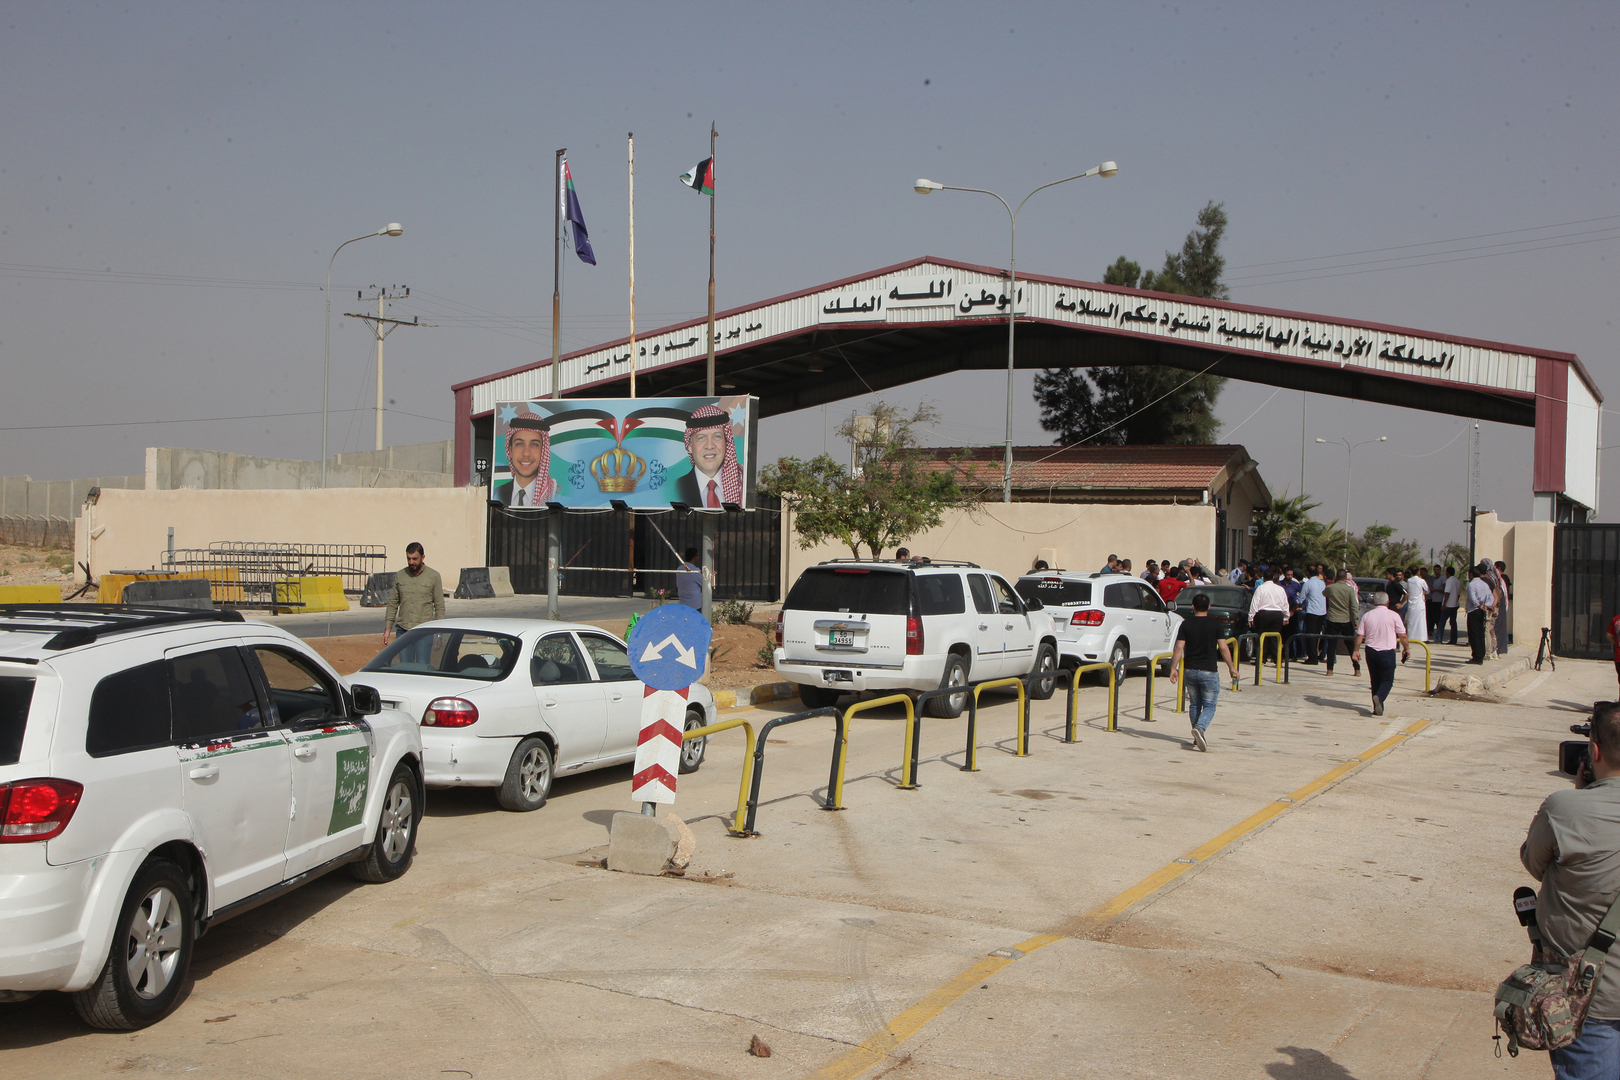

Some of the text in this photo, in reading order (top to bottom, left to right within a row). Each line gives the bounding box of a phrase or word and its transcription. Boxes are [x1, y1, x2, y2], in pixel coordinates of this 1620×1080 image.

[888, 278, 952, 301] الله
[959, 287, 1022, 313] اوطن
[823, 295, 881, 314] الملك
[707, 322, 762, 344] مديري
[1055, 292, 1455, 371] المملكة الأردنية الهاشمية تستودعكم السلامة
[639, 336, 699, 356] حدود
